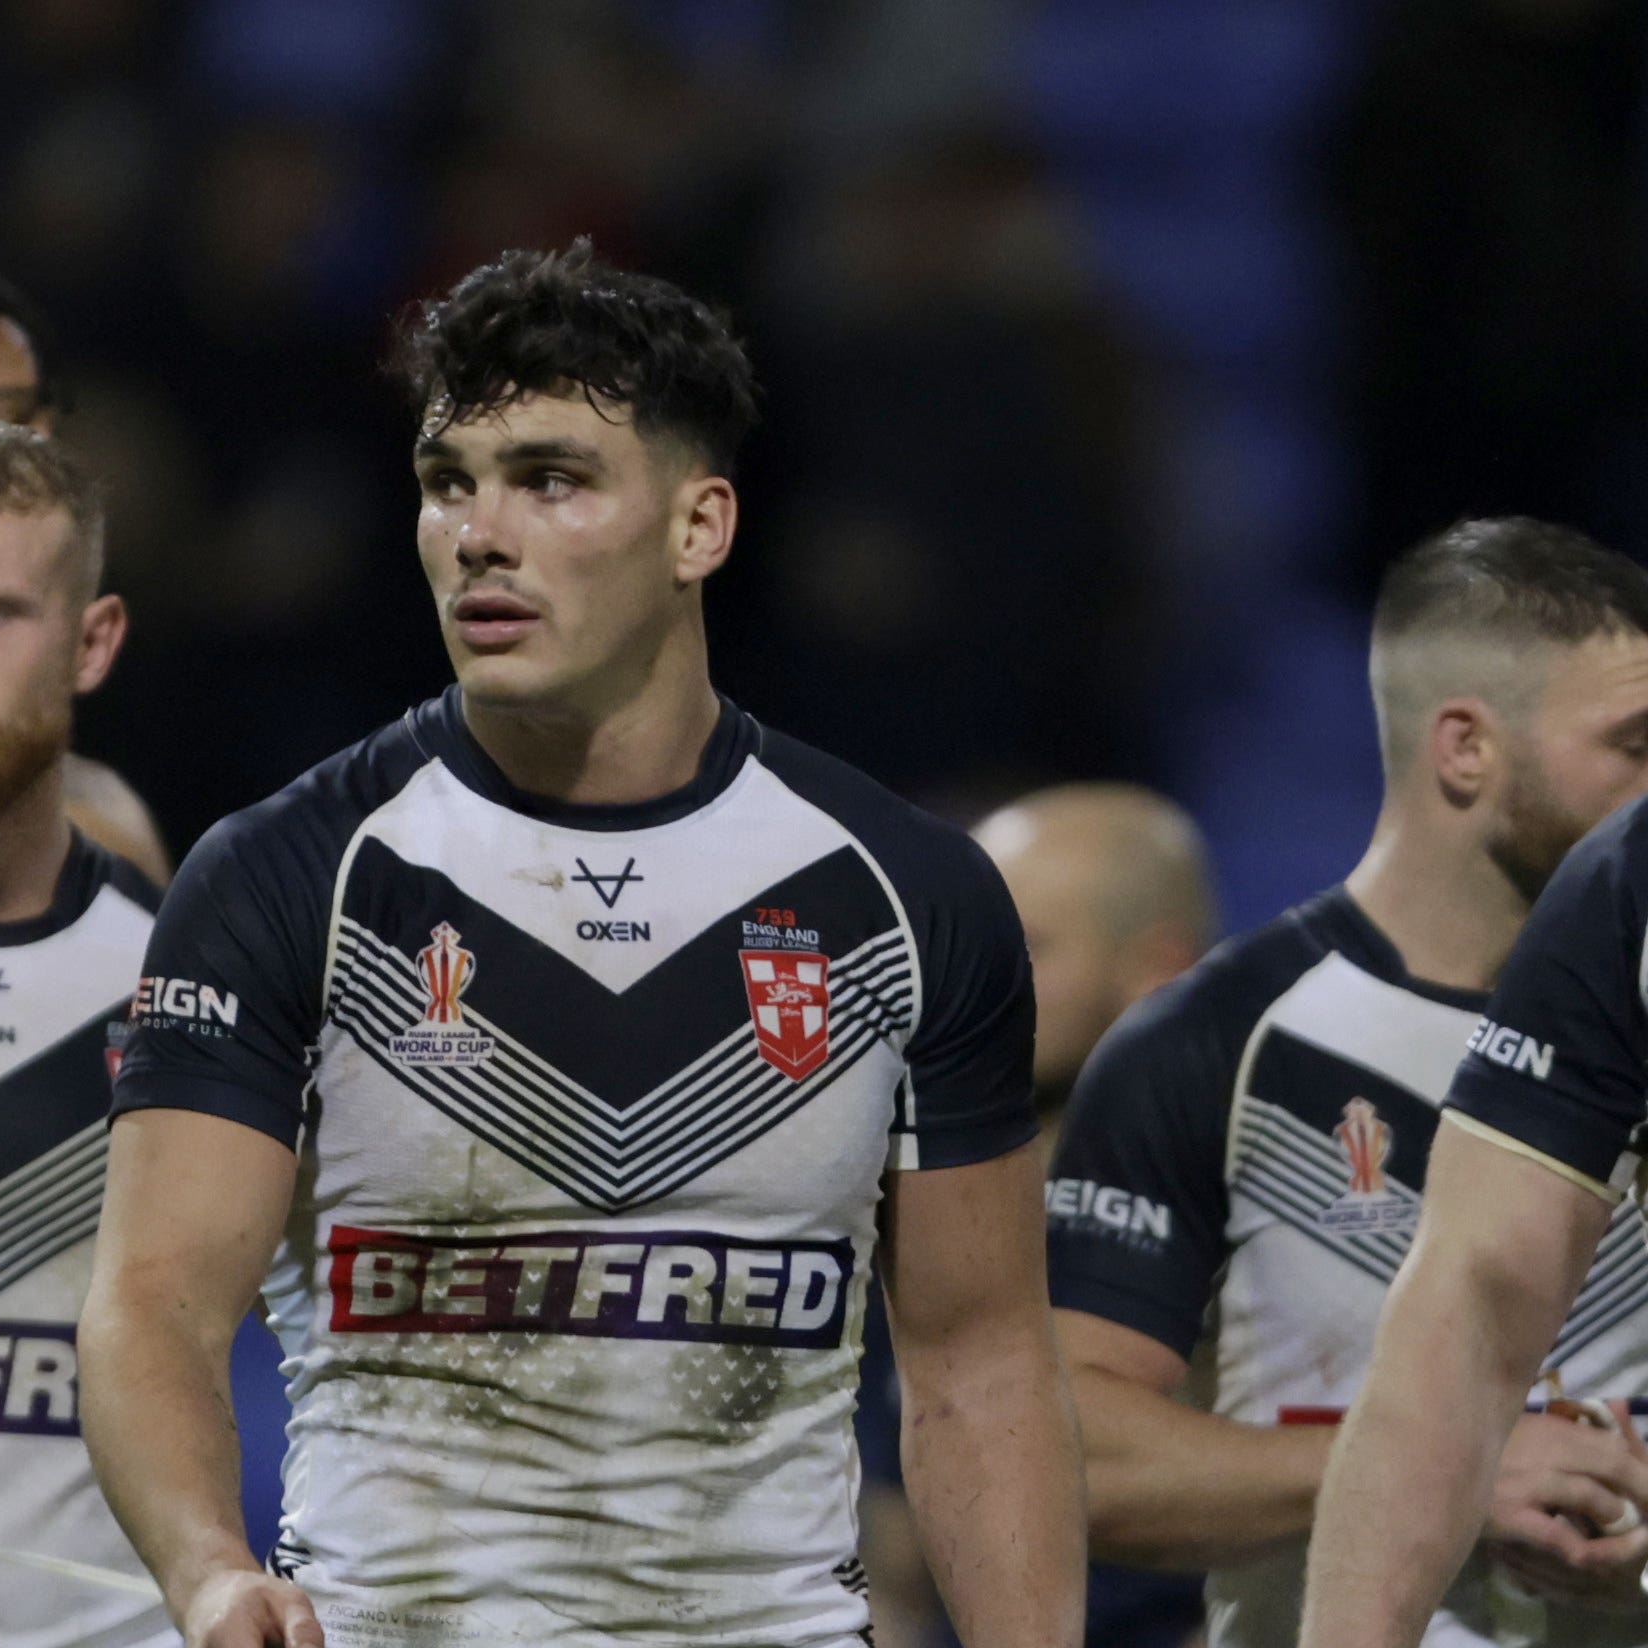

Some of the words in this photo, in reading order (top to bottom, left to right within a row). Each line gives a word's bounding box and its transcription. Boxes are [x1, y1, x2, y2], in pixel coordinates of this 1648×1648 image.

[756, 907, 797, 928] 759
[576, 920, 650, 942] OXEN
[742, 920, 819, 946] ENGLAND
[743, 936, 780, 949] RUGBY
[132, 976, 239, 1027] EIGN
[392, 1040, 453, 1054] WORLD
[457, 1040, 491, 1054] CUP
[1044, 1177, 1170, 1240] EIGN
[348, 1244, 843, 1332] BETFRED
